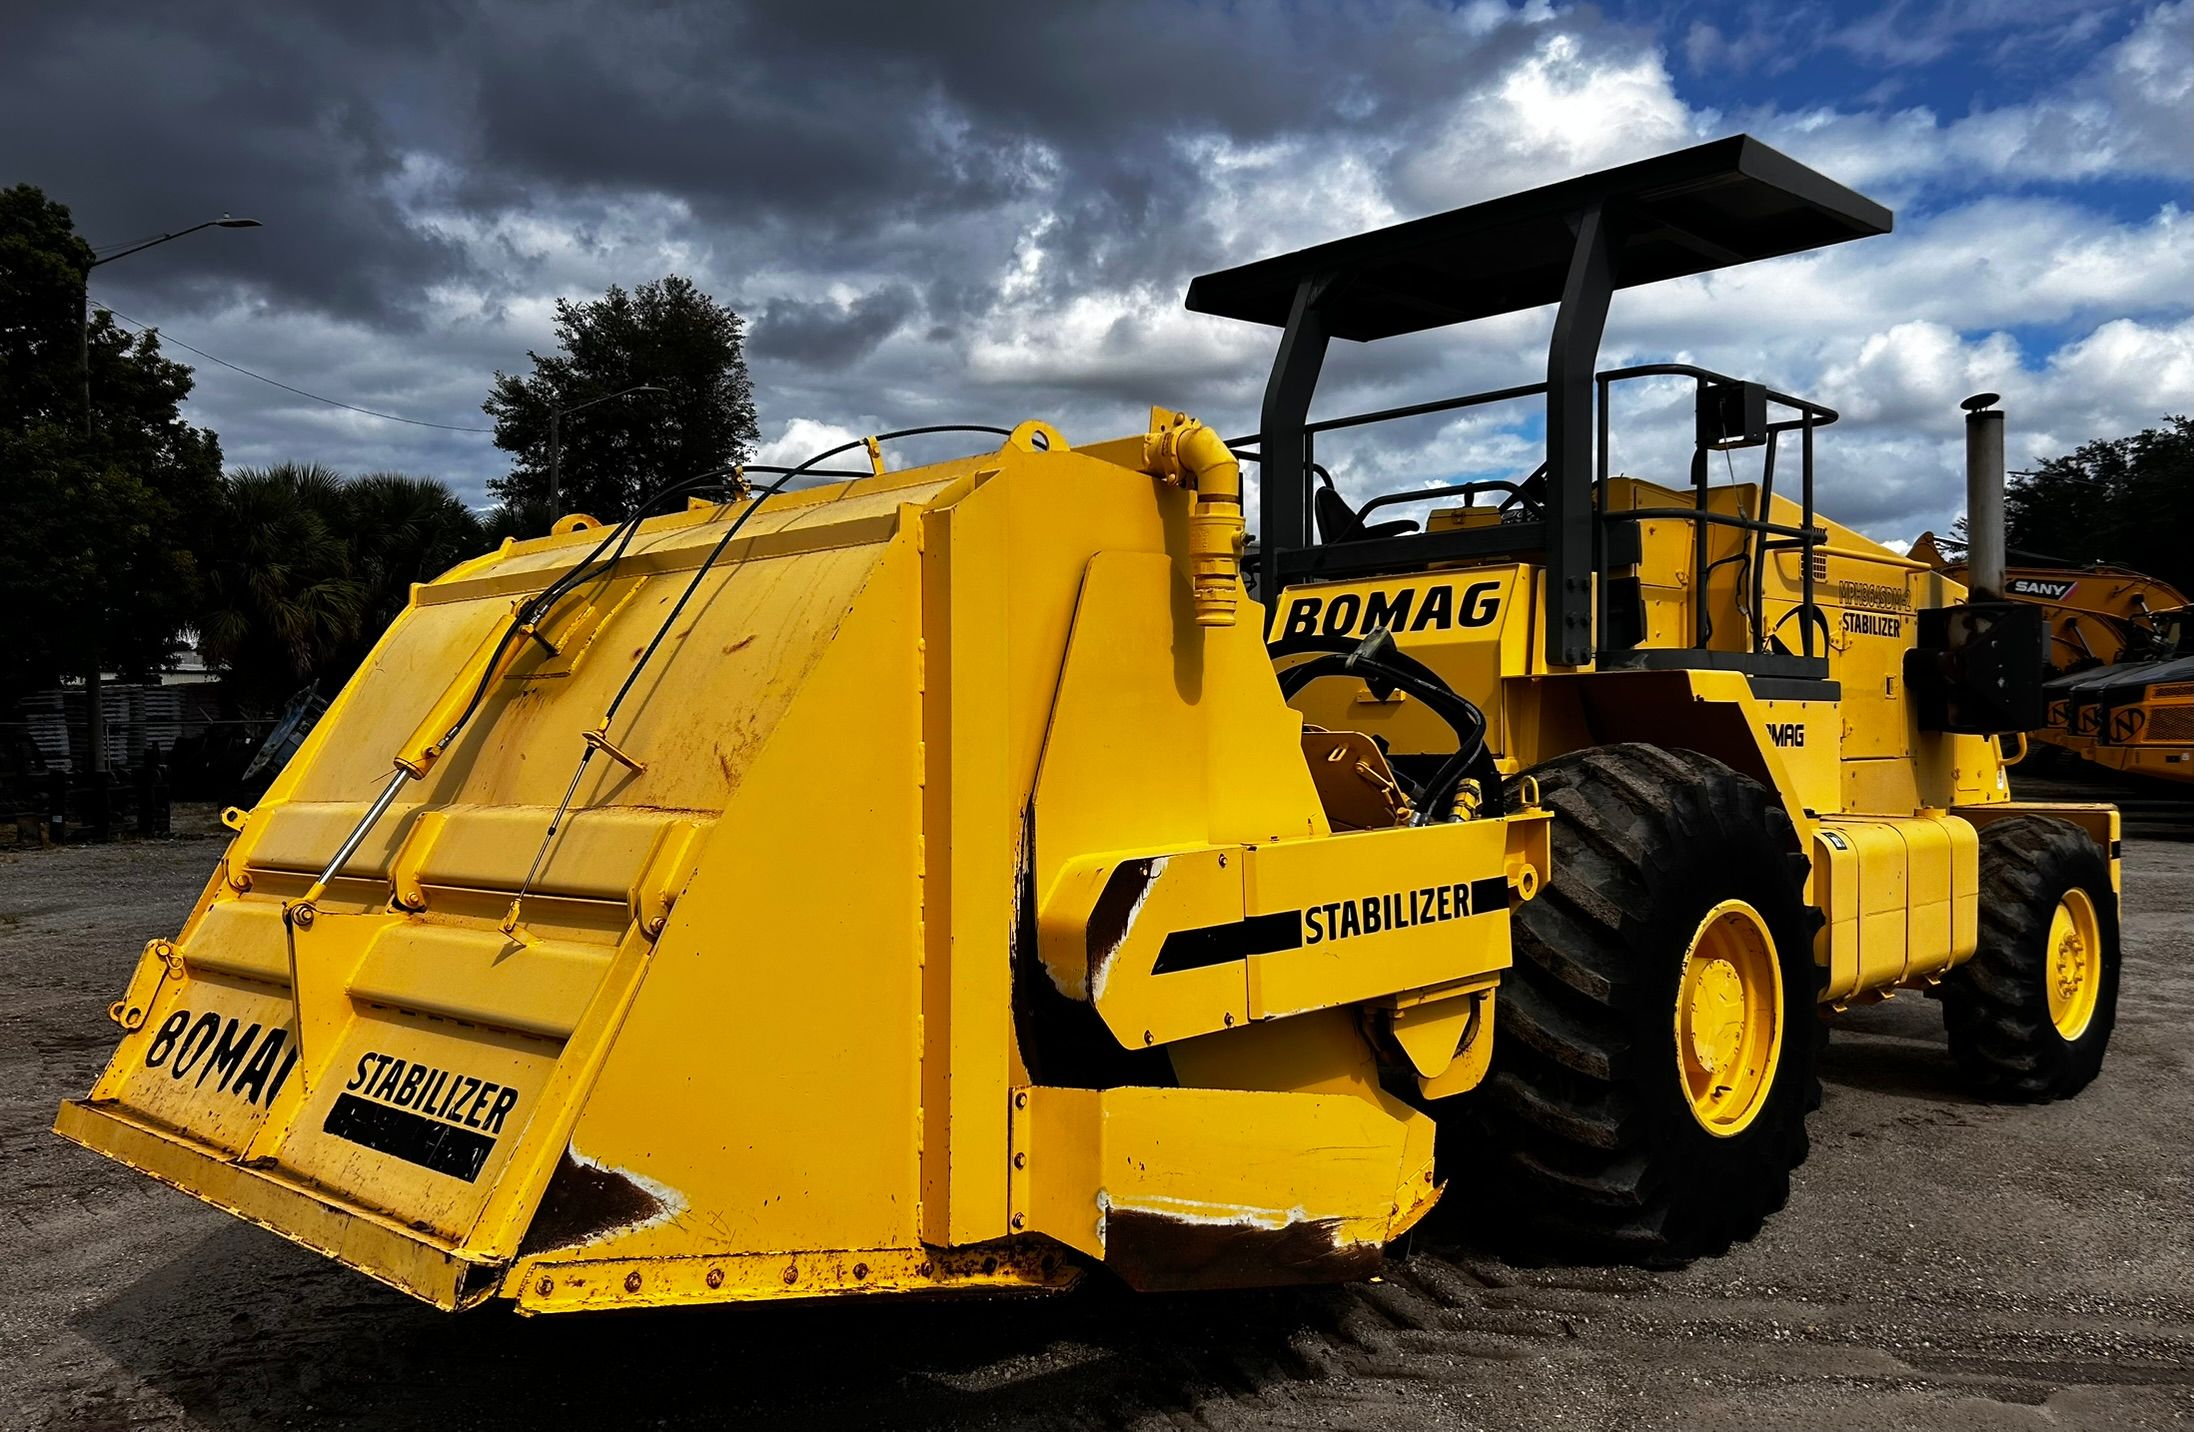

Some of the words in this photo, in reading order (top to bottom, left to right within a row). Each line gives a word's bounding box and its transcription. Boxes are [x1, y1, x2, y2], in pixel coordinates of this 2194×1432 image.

[1282, 580, 1501, 639] BOMAG
[2014, 581, 2067, 596] SANY
[1842, 612, 1901, 639] STABILIZER
[1304, 882, 1471, 945] STABILIZER
[346, 1051, 519, 1134] STABILIZER
